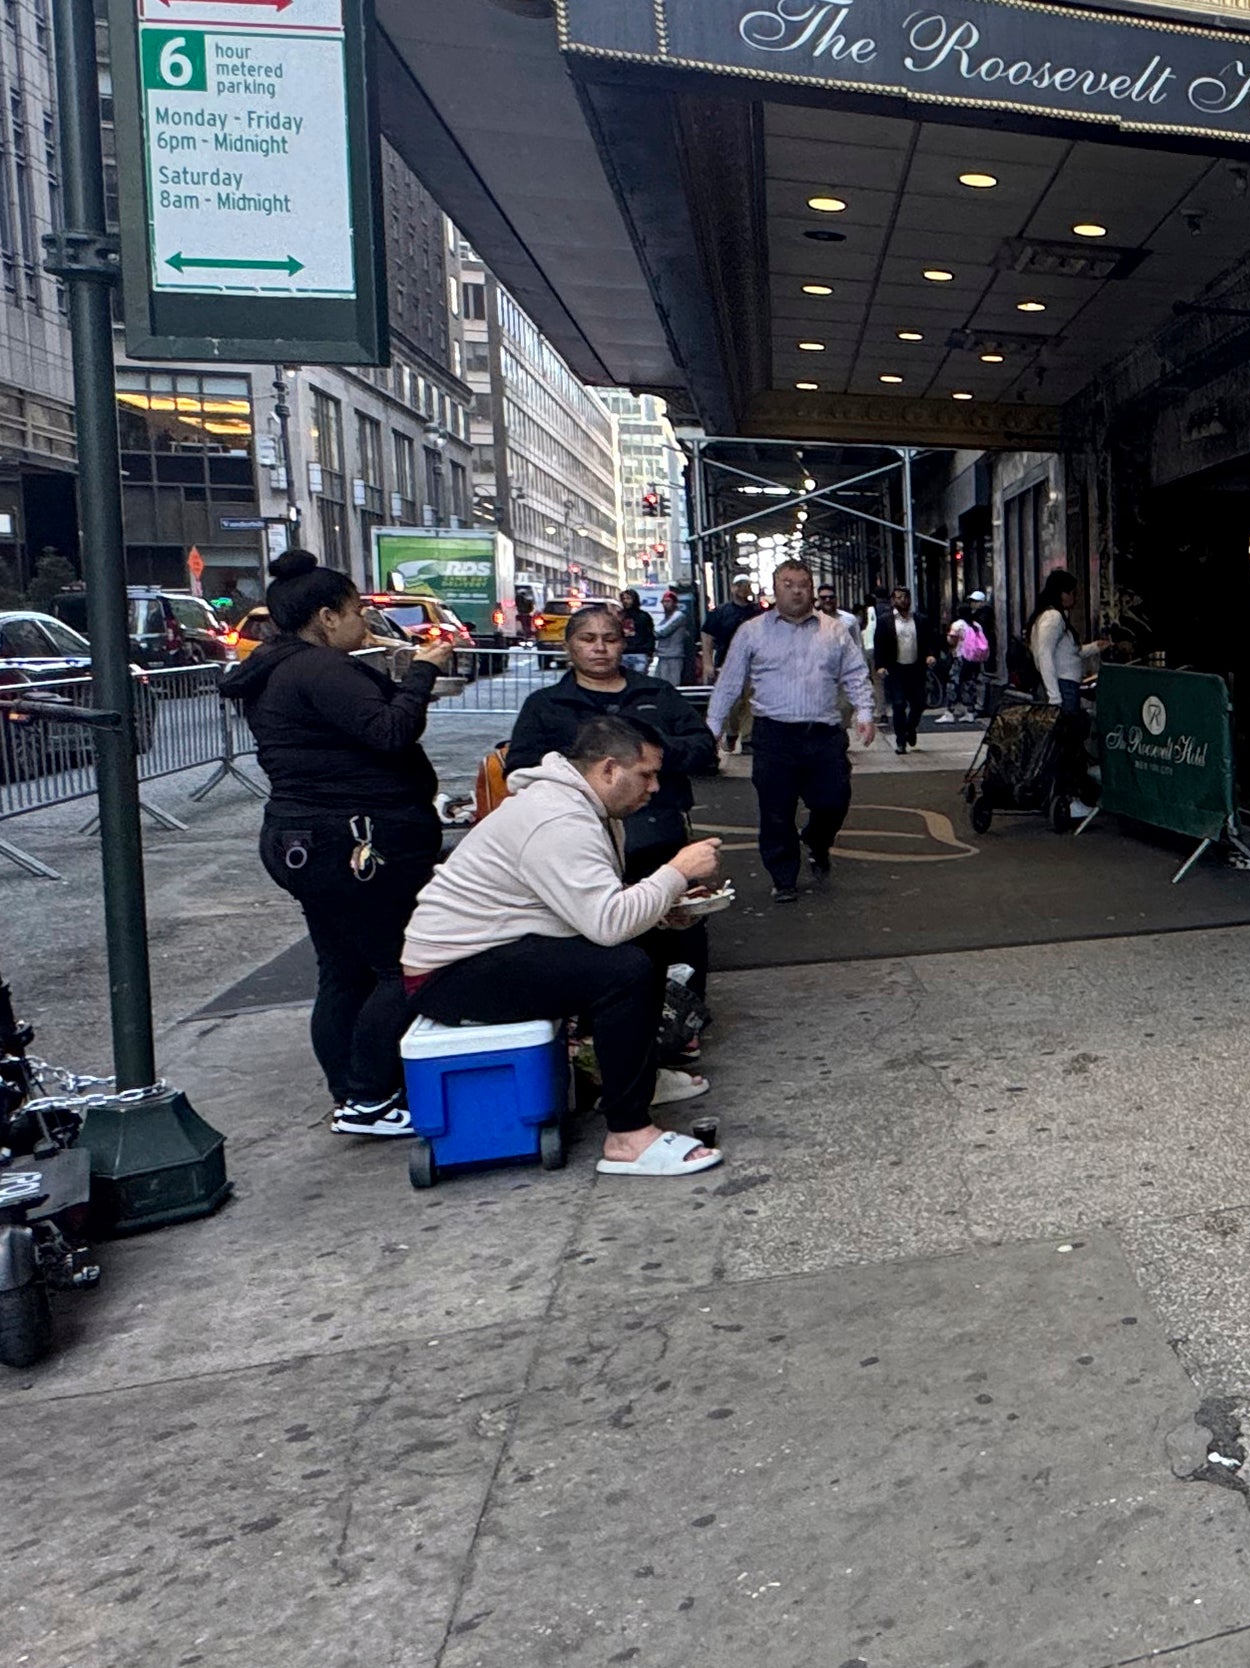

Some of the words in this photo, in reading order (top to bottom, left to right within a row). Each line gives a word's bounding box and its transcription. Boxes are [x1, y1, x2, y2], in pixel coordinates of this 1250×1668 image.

[160, 36, 193, 86] 6
[215, 43, 252, 59] hour
[739, 0, 878, 63] The
[902, 9, 1177, 104] Roosevelt
[216, 62, 283, 78] metered
[216, 80, 276, 99] parking
[155, 107, 228, 131] Monday
[247, 110, 303, 135] Friday
[156, 131, 197, 153] 6pm
[214, 133, 288, 157] Midnight
[158, 165, 243, 191] Saturday
[160, 190, 199, 209] 8am
[217, 191, 291, 216] Midnight
